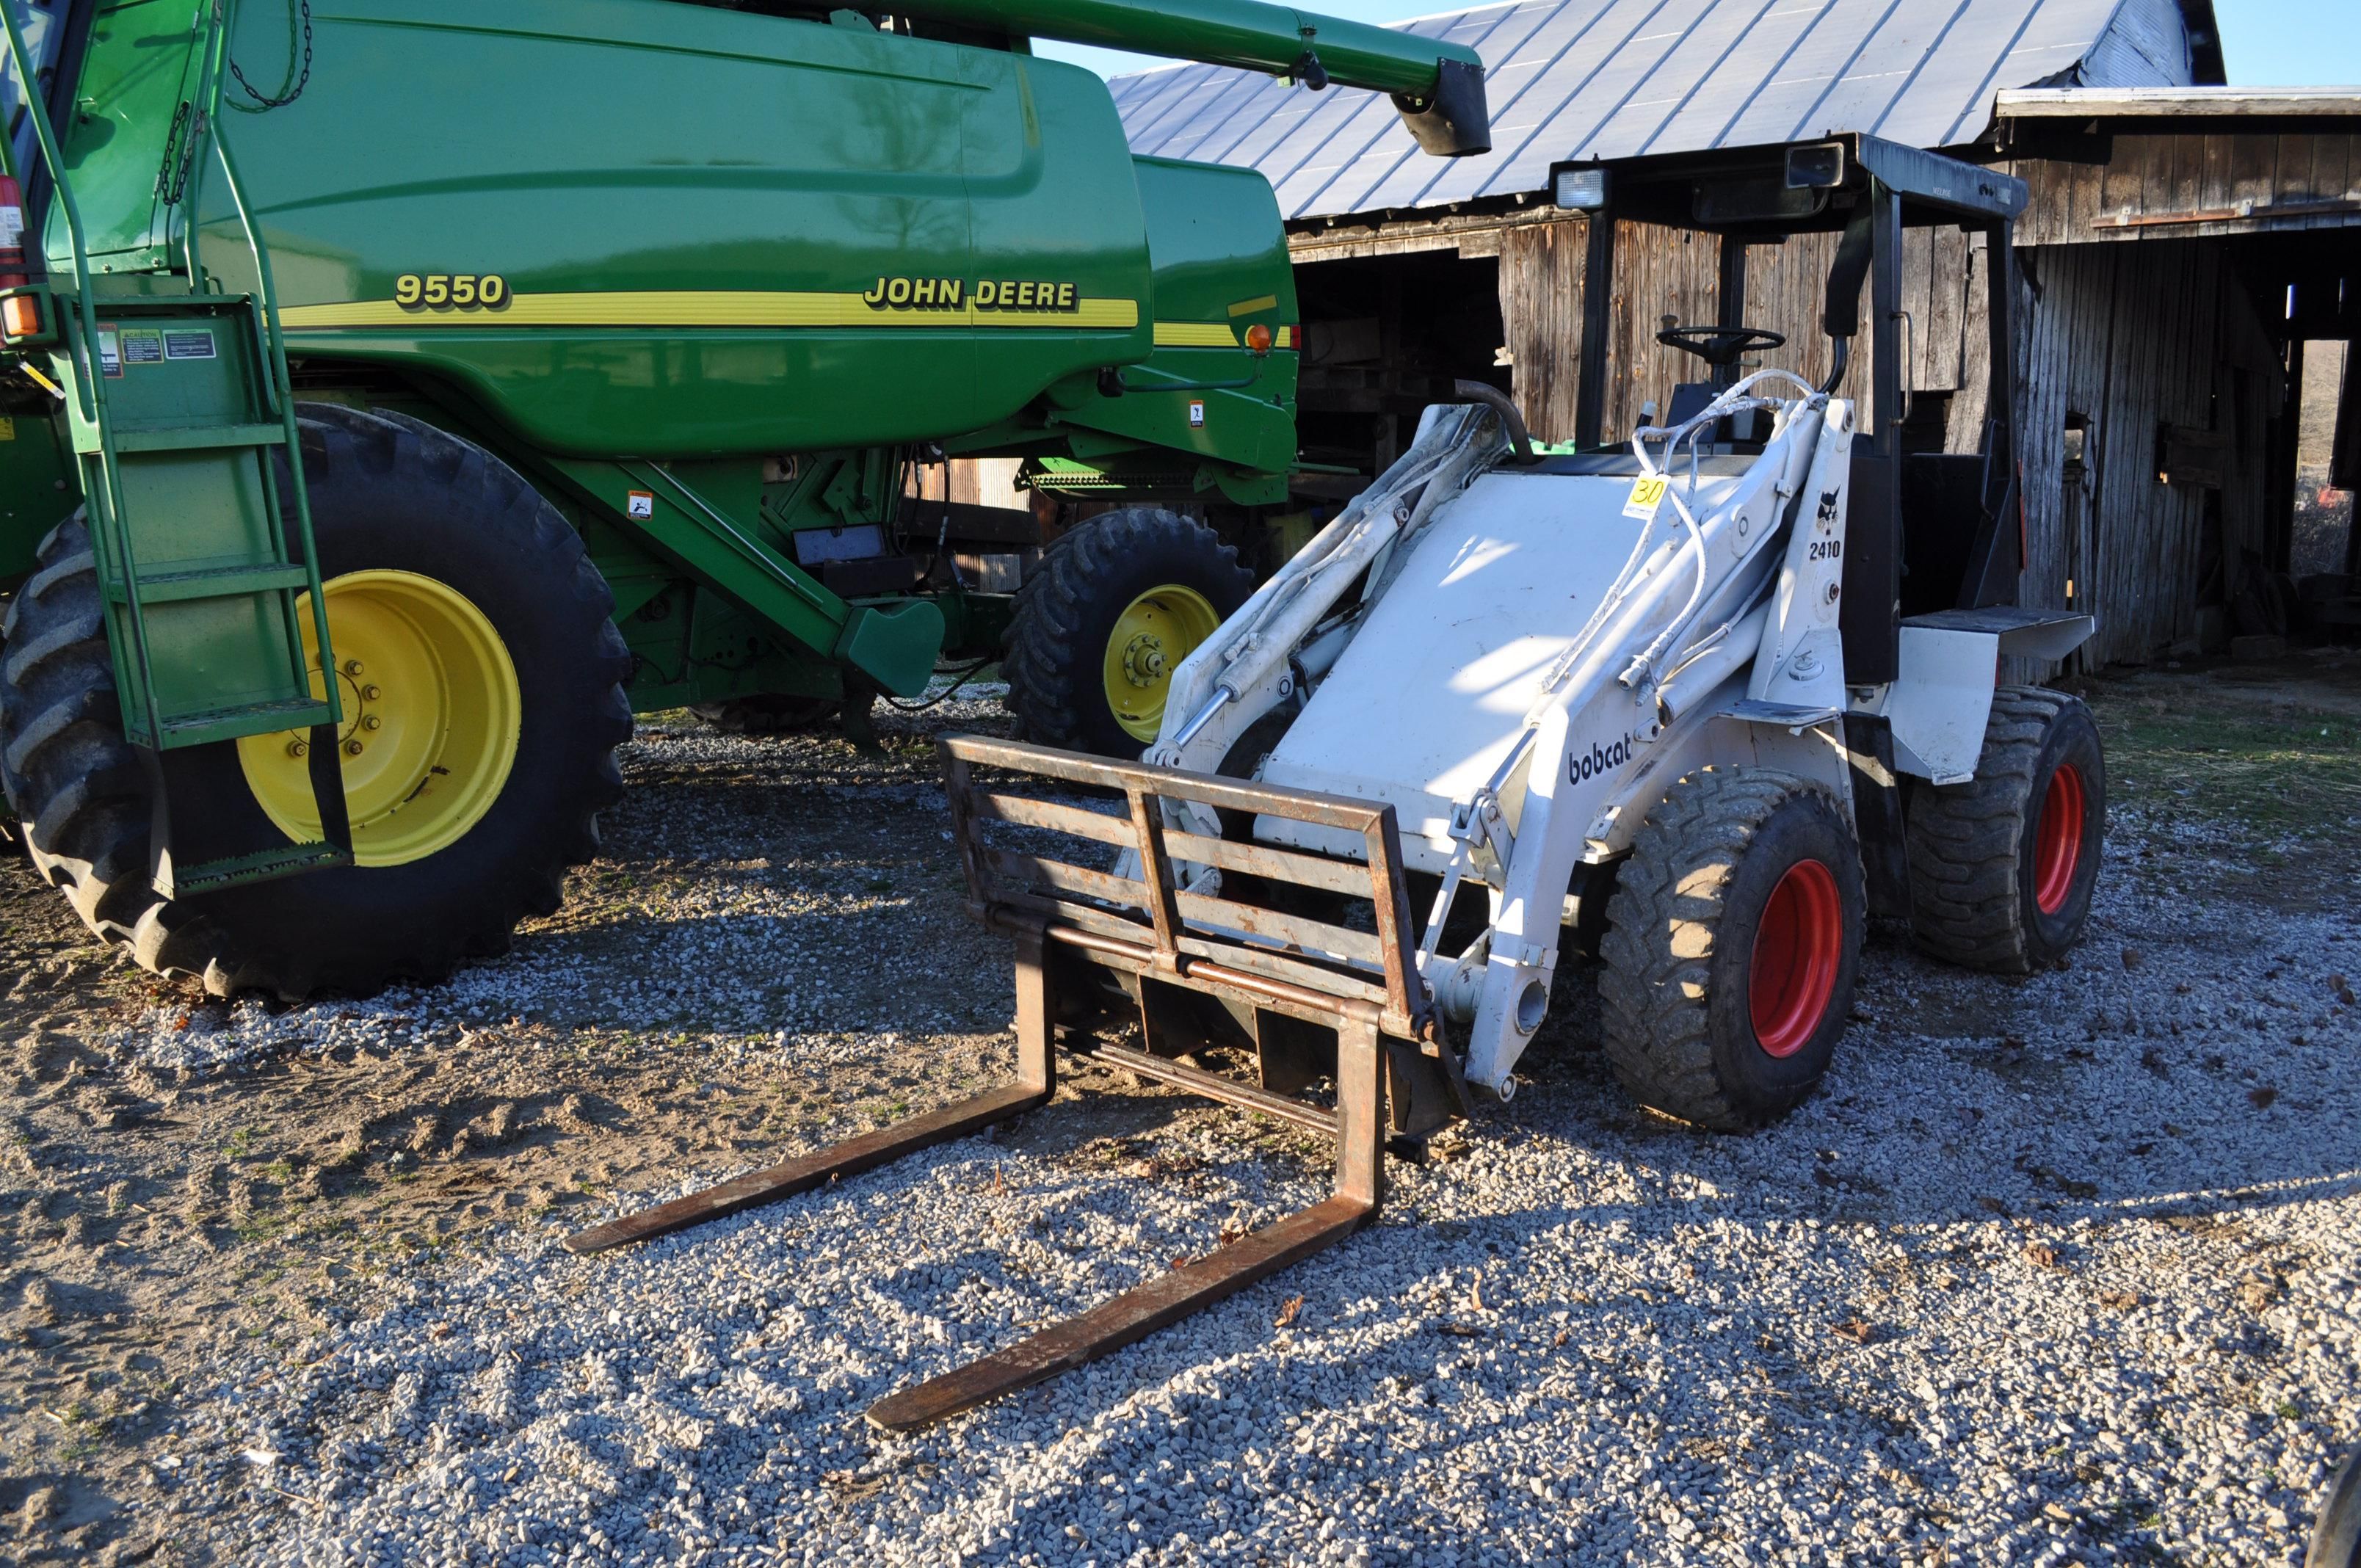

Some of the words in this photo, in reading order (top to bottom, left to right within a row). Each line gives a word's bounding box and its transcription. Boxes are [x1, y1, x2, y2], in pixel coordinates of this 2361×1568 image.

[395, 274, 508, 309] 9550
[863, 277, 965, 310] JOHN
[974, 280, 1076, 311] DEERE
[1633, 480, 1664, 503] 30
[1810, 540, 1840, 561] 2410
[1569, 733, 1631, 785] bobcat
